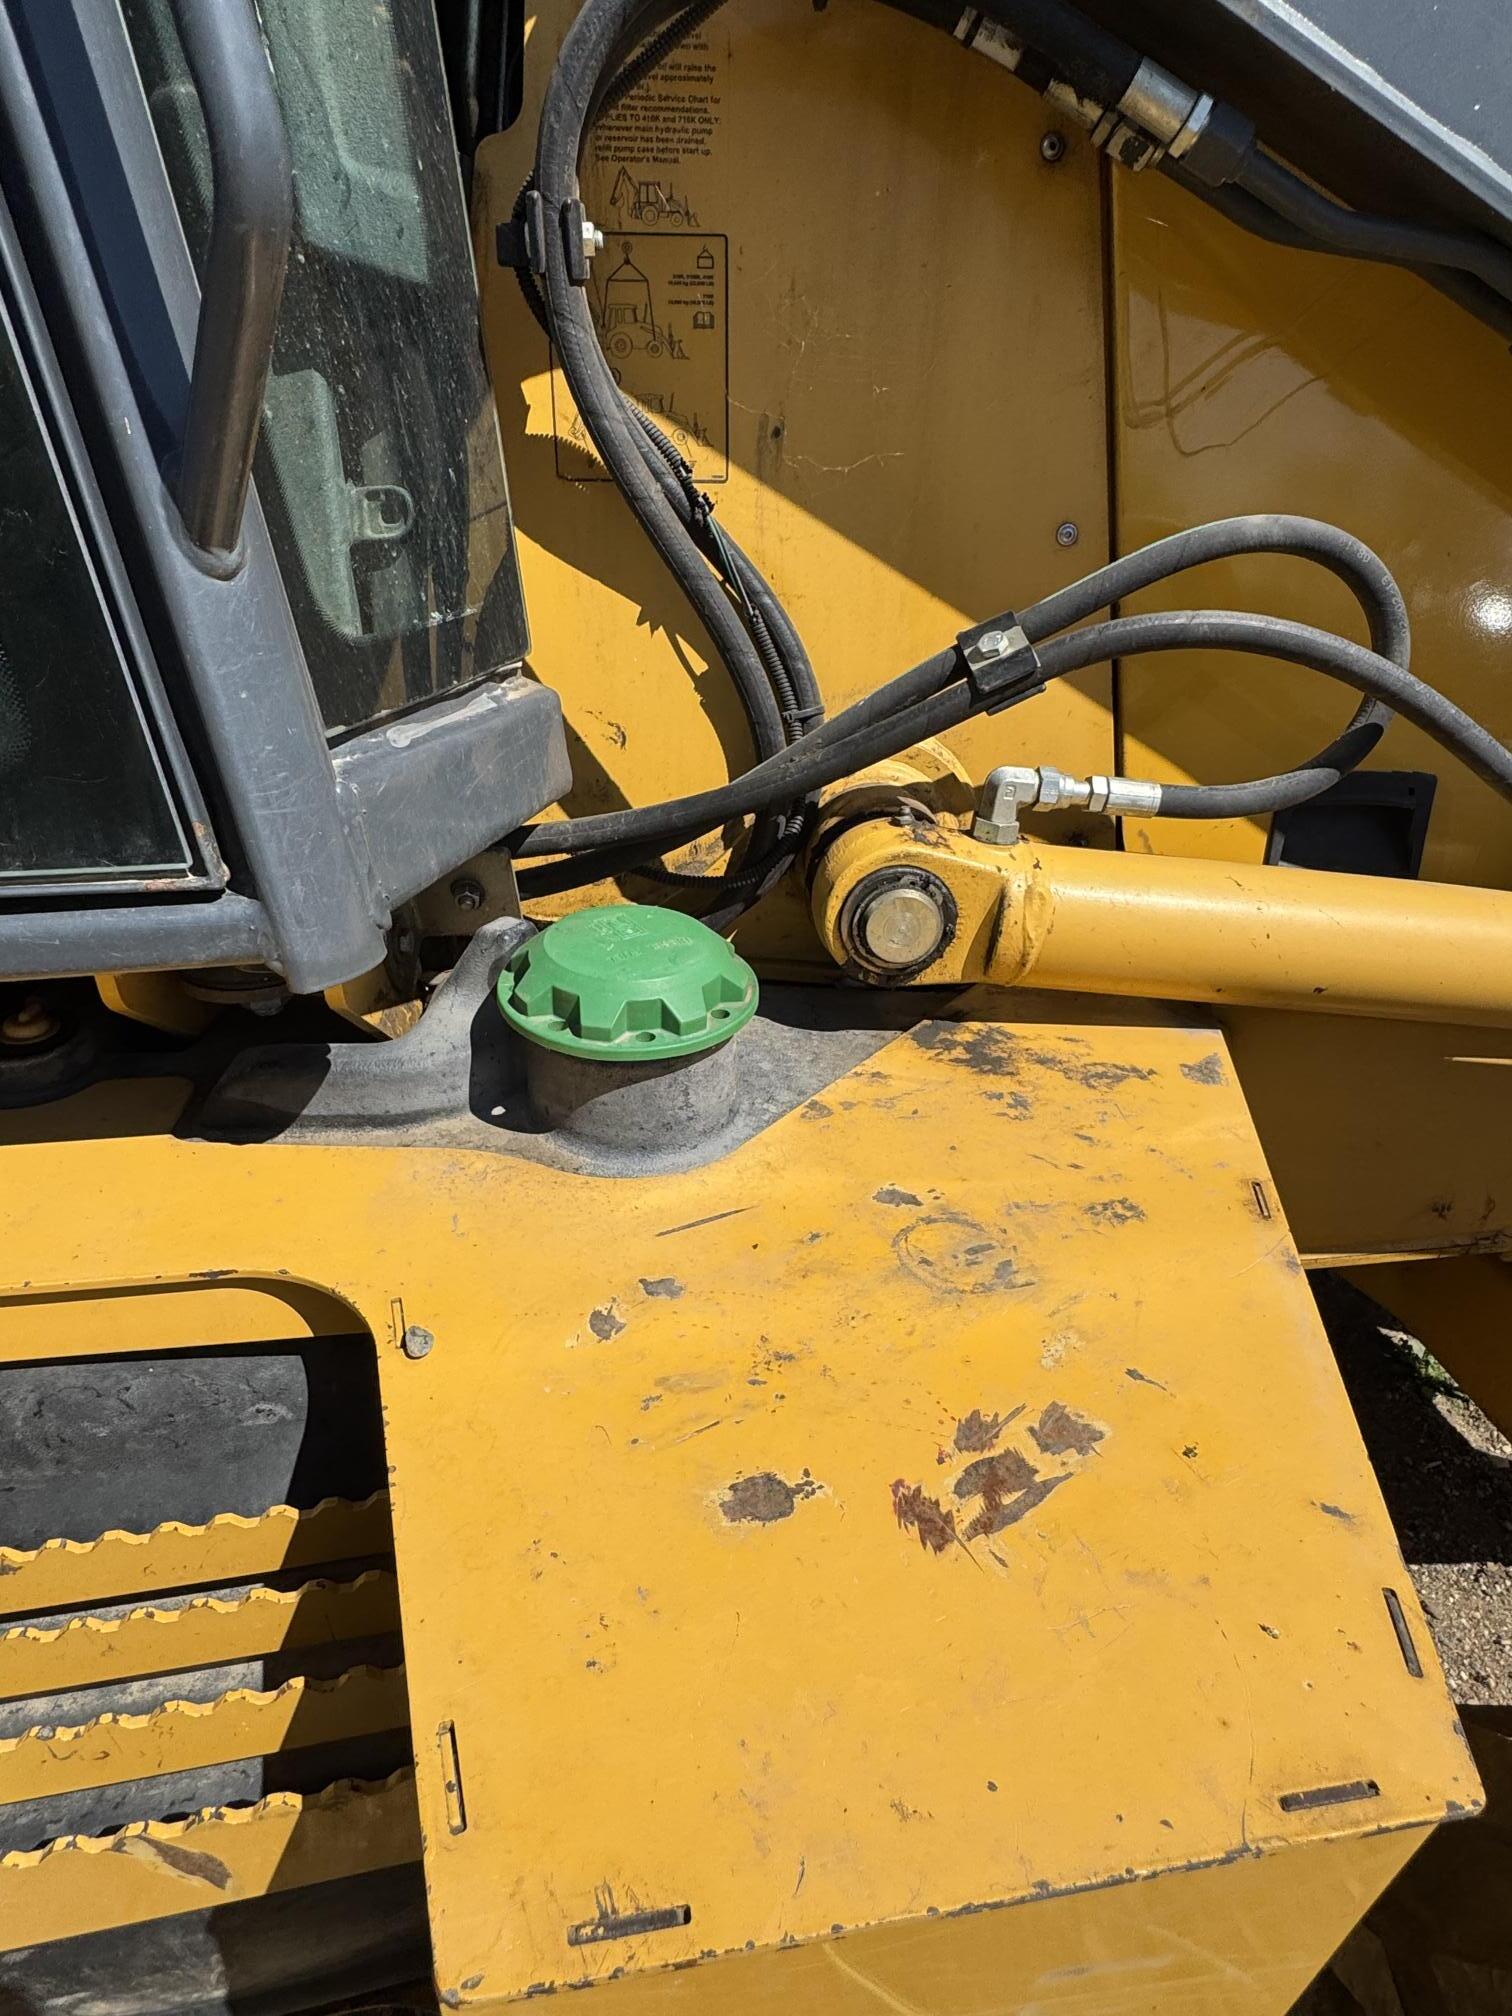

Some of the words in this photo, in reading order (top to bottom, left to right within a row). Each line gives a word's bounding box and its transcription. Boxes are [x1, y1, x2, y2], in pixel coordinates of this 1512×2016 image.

[705, 64, 716, 72] the
[660, 74, 714, 85] approximately
[658, 95, 685, 103] Service
[688, 95, 708, 104] Chart
[711, 95, 720, 104] for
[641, 105, 709, 113] recommendations.
[630, 114, 640, 122] TO
[663, 115, 676, 123] and
[655, 126, 688, 135] hydraulic
[691, 127, 712, 135] pump
[640, 135, 654, 143] has
[656, 135, 674, 144] been
[613, 145, 635, 154] pump
[657, 146, 680, 154] before
[682, 147, 699, 155] start
[611, 154, 650, 163] Operator's
